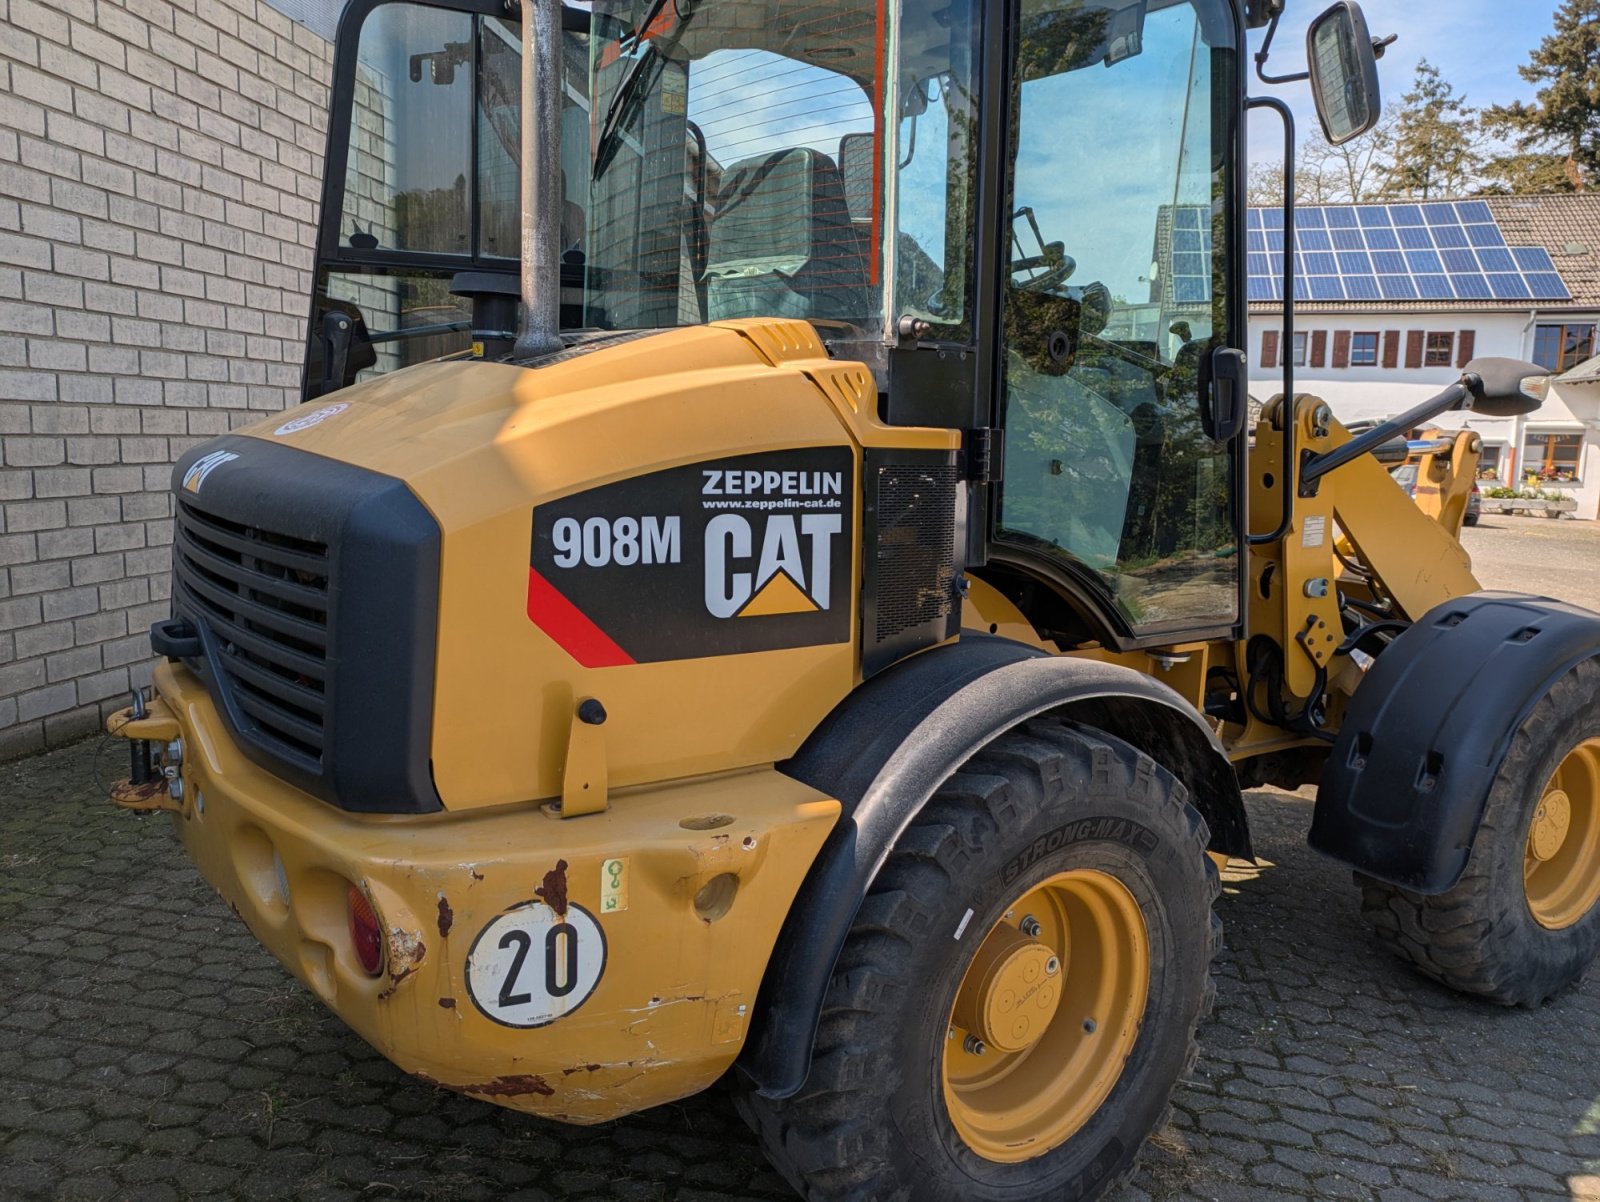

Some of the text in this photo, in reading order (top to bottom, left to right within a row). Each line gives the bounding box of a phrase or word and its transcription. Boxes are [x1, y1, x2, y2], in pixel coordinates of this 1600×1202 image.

[702, 470, 842, 495] ZEPPELIN
[702, 498, 842, 510] www.zeppelin-cat.de
[552, 515, 681, 568] 908M
[704, 513, 842, 619] CAT
[498, 922, 578, 1008] 20
